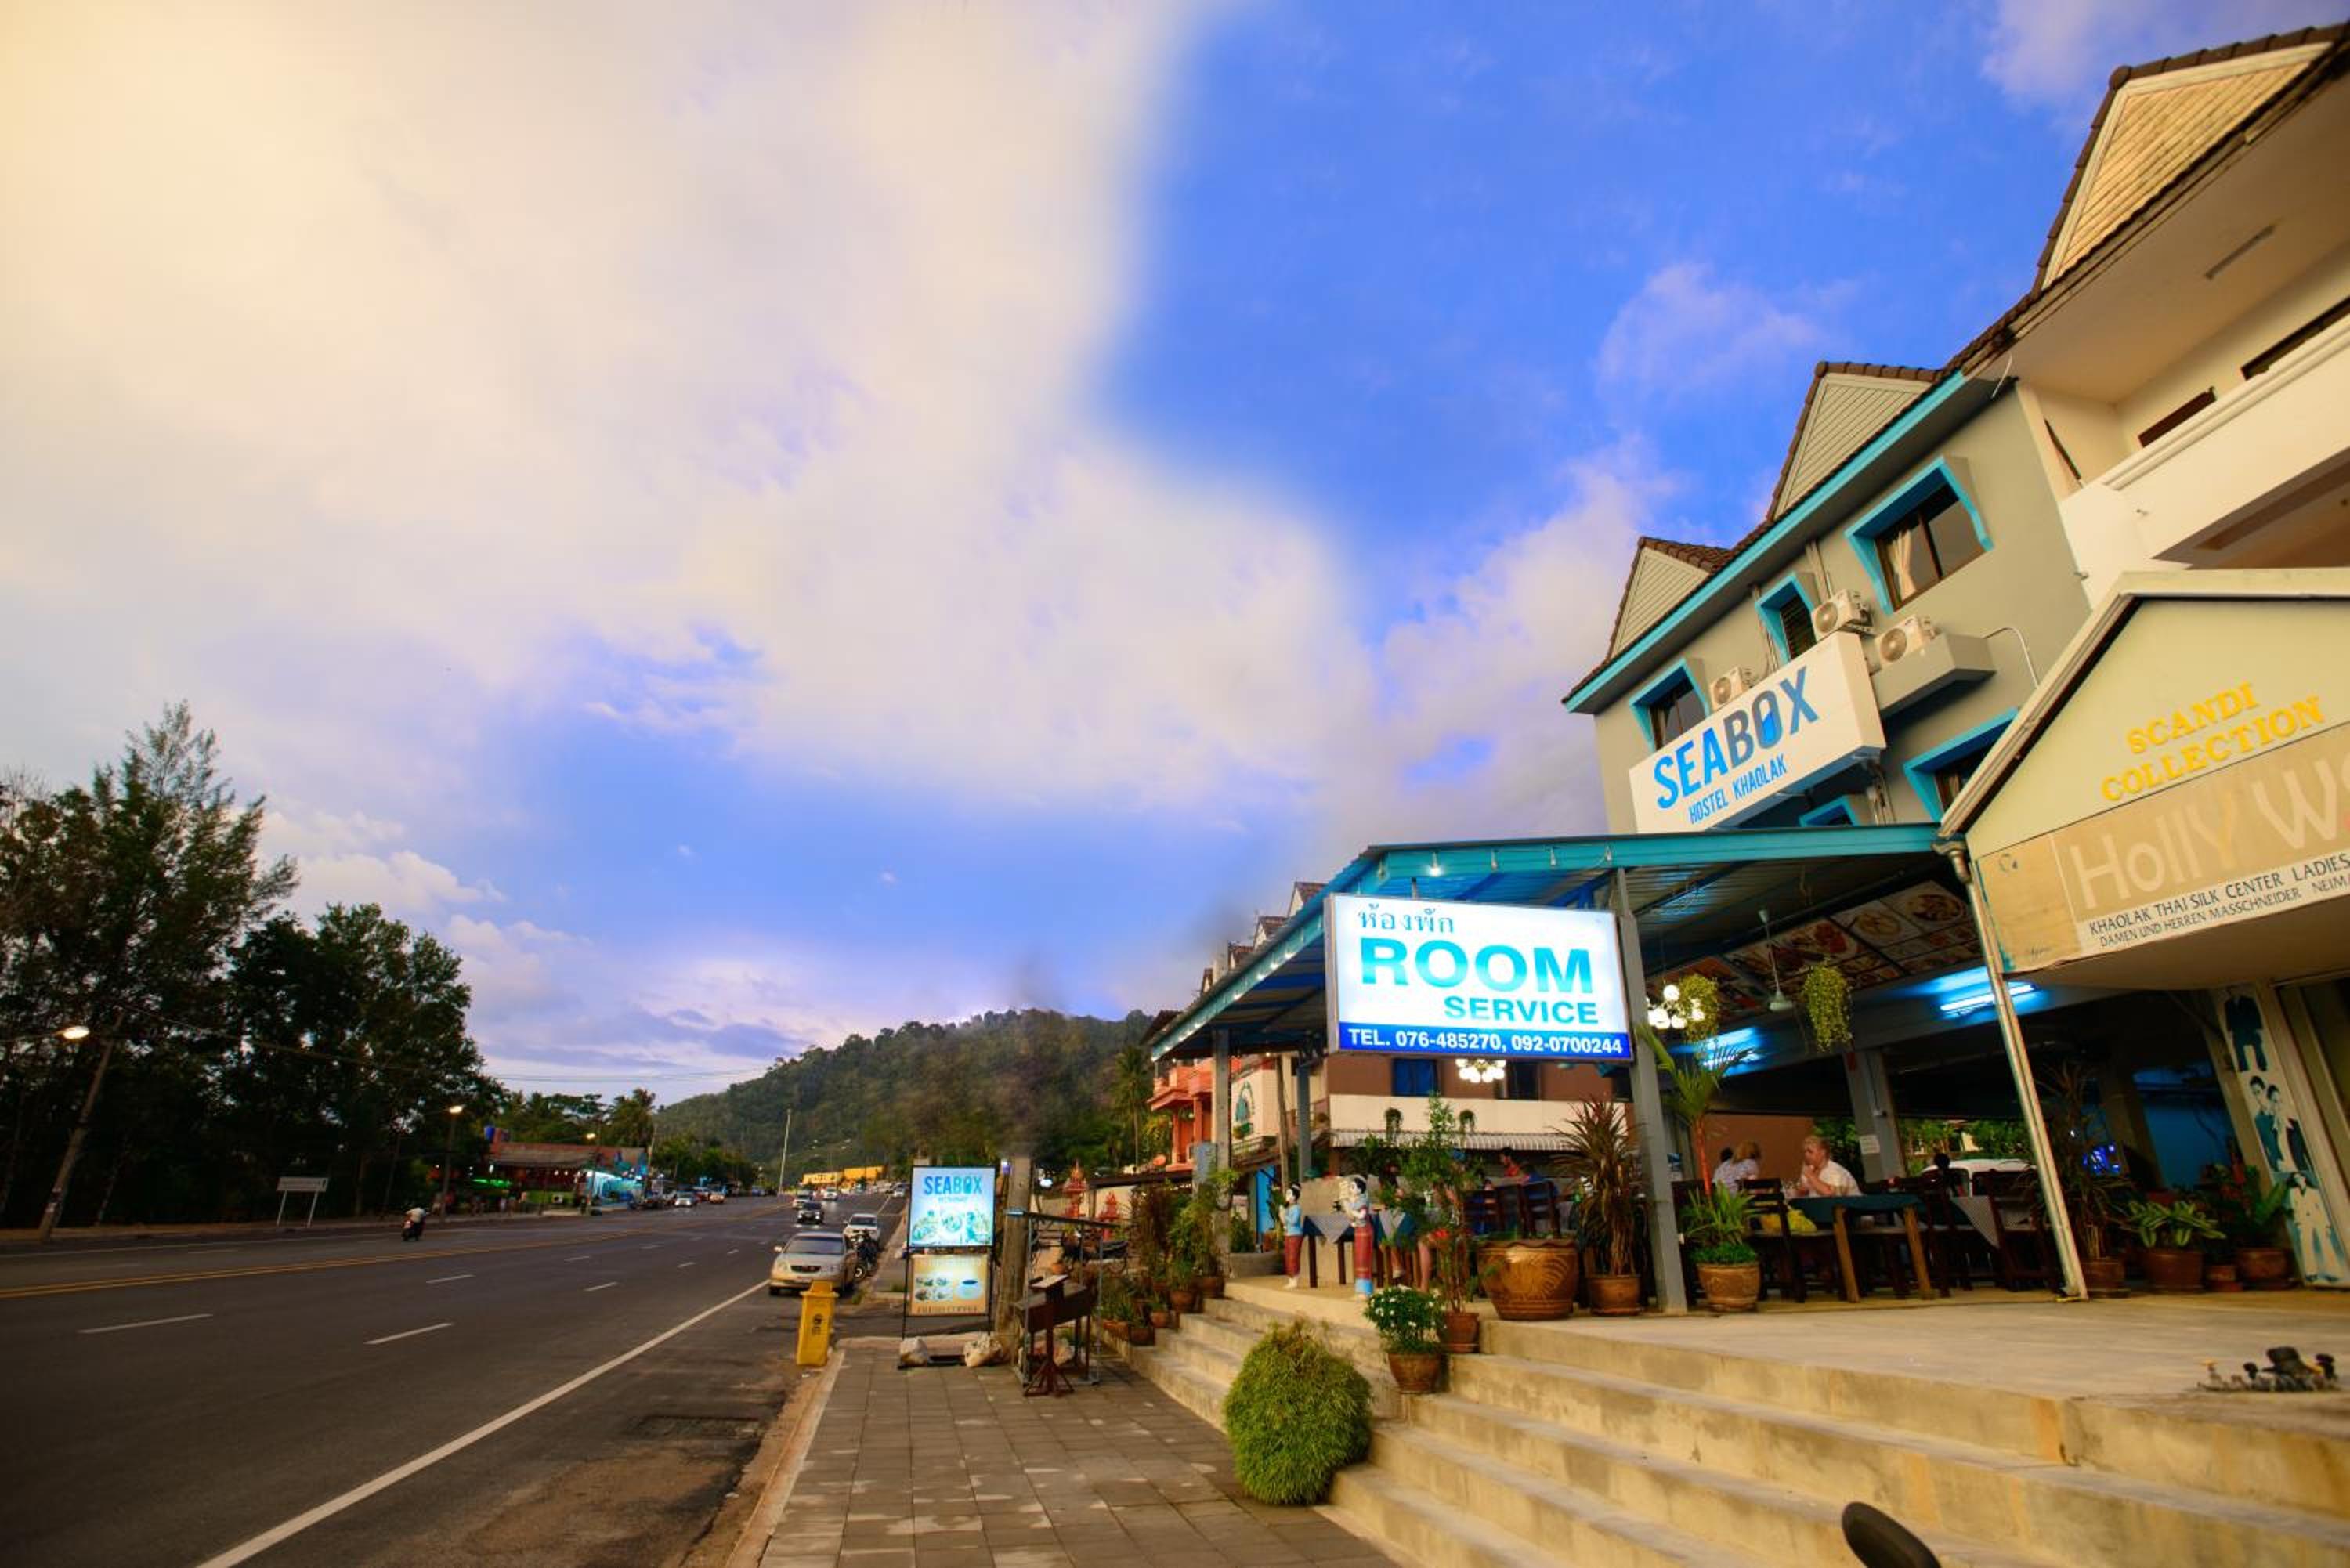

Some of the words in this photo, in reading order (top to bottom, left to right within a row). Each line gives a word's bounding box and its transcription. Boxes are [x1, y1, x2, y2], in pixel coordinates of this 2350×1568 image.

[1653, 665, 1820, 810] SEABOX
[2100, 695, 2326, 802] COLLECTION
[2125, 681, 2261, 754] SCANDI
[1688, 788, 1729, 825] HOSTEL
[1732, 753, 1788, 800] KHAOLAK
[1358, 902, 1455, 934] ห้องพัก
[2089, 906, 2153, 936] KHAOLAK
[2154, 898, 2189, 918] THAI
[2190, 888, 2220, 908] SILK
[2225, 871, 2284, 899] CENTER
[2291, 852, 2350, 882] LADIES
[2099, 929, 2138, 948] DAMEN
[2139, 921, 2163, 938] UND
[2164, 910, 2207, 930] HERREN
[2208, 886, 2302, 919] MASSCHNEIDER
[1361, 937, 1593, 994] ROOM
[1444, 995, 1599, 1024] SERVICE
[1348, 1028, 1391, 1046] TEL.
[1395, 1031, 1506, 1053] 076-485270,
[1511, 1037, 1623, 1054] 092-0700244
[924, 1175, 983, 1195] SEABOX
